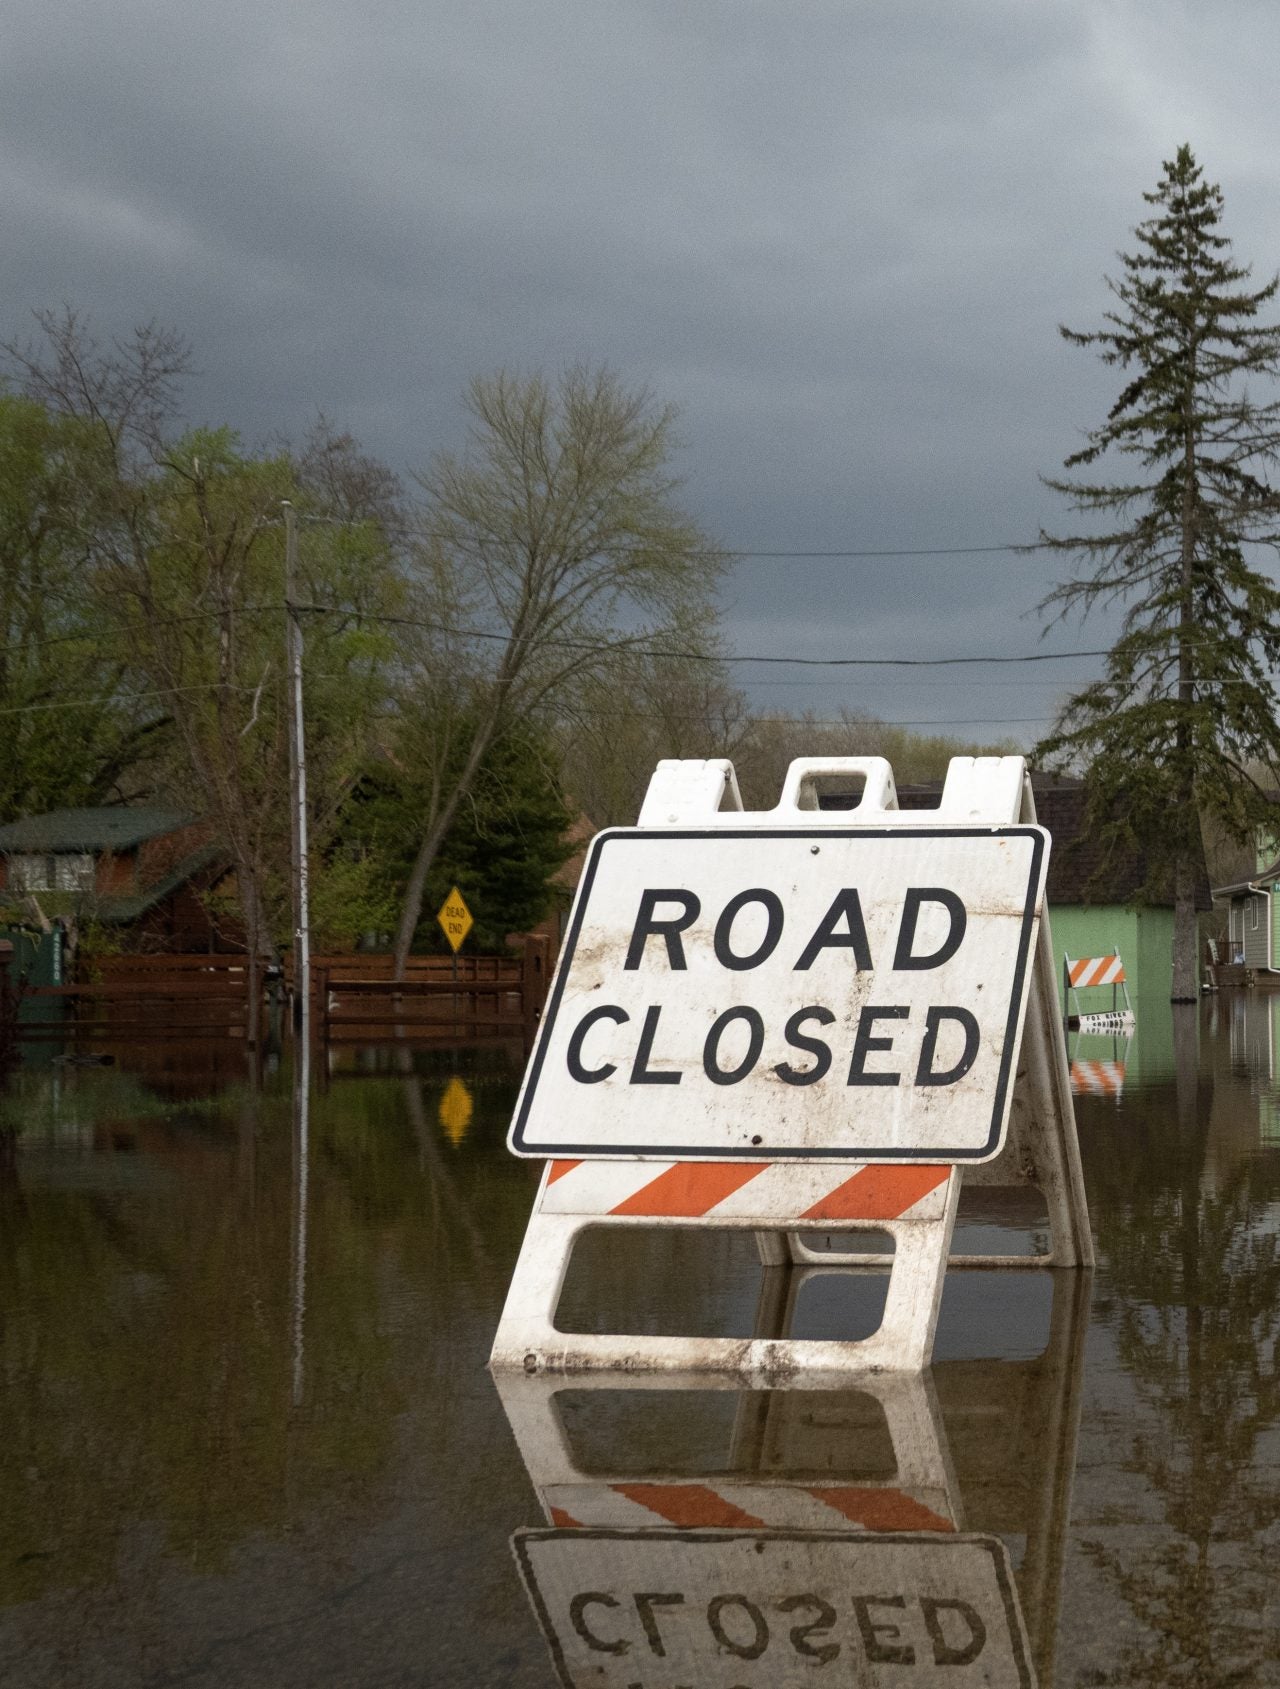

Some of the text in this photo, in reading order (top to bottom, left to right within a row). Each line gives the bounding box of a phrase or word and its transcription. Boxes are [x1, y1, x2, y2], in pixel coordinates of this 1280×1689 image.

[446, 906, 464, 918] DEAD
[449, 922, 462, 934] END
[623, 887, 967, 971] ROAD
[1105, 1012, 1127, 1020] RIVER
[566, 1004, 980, 1087] CLOSED
